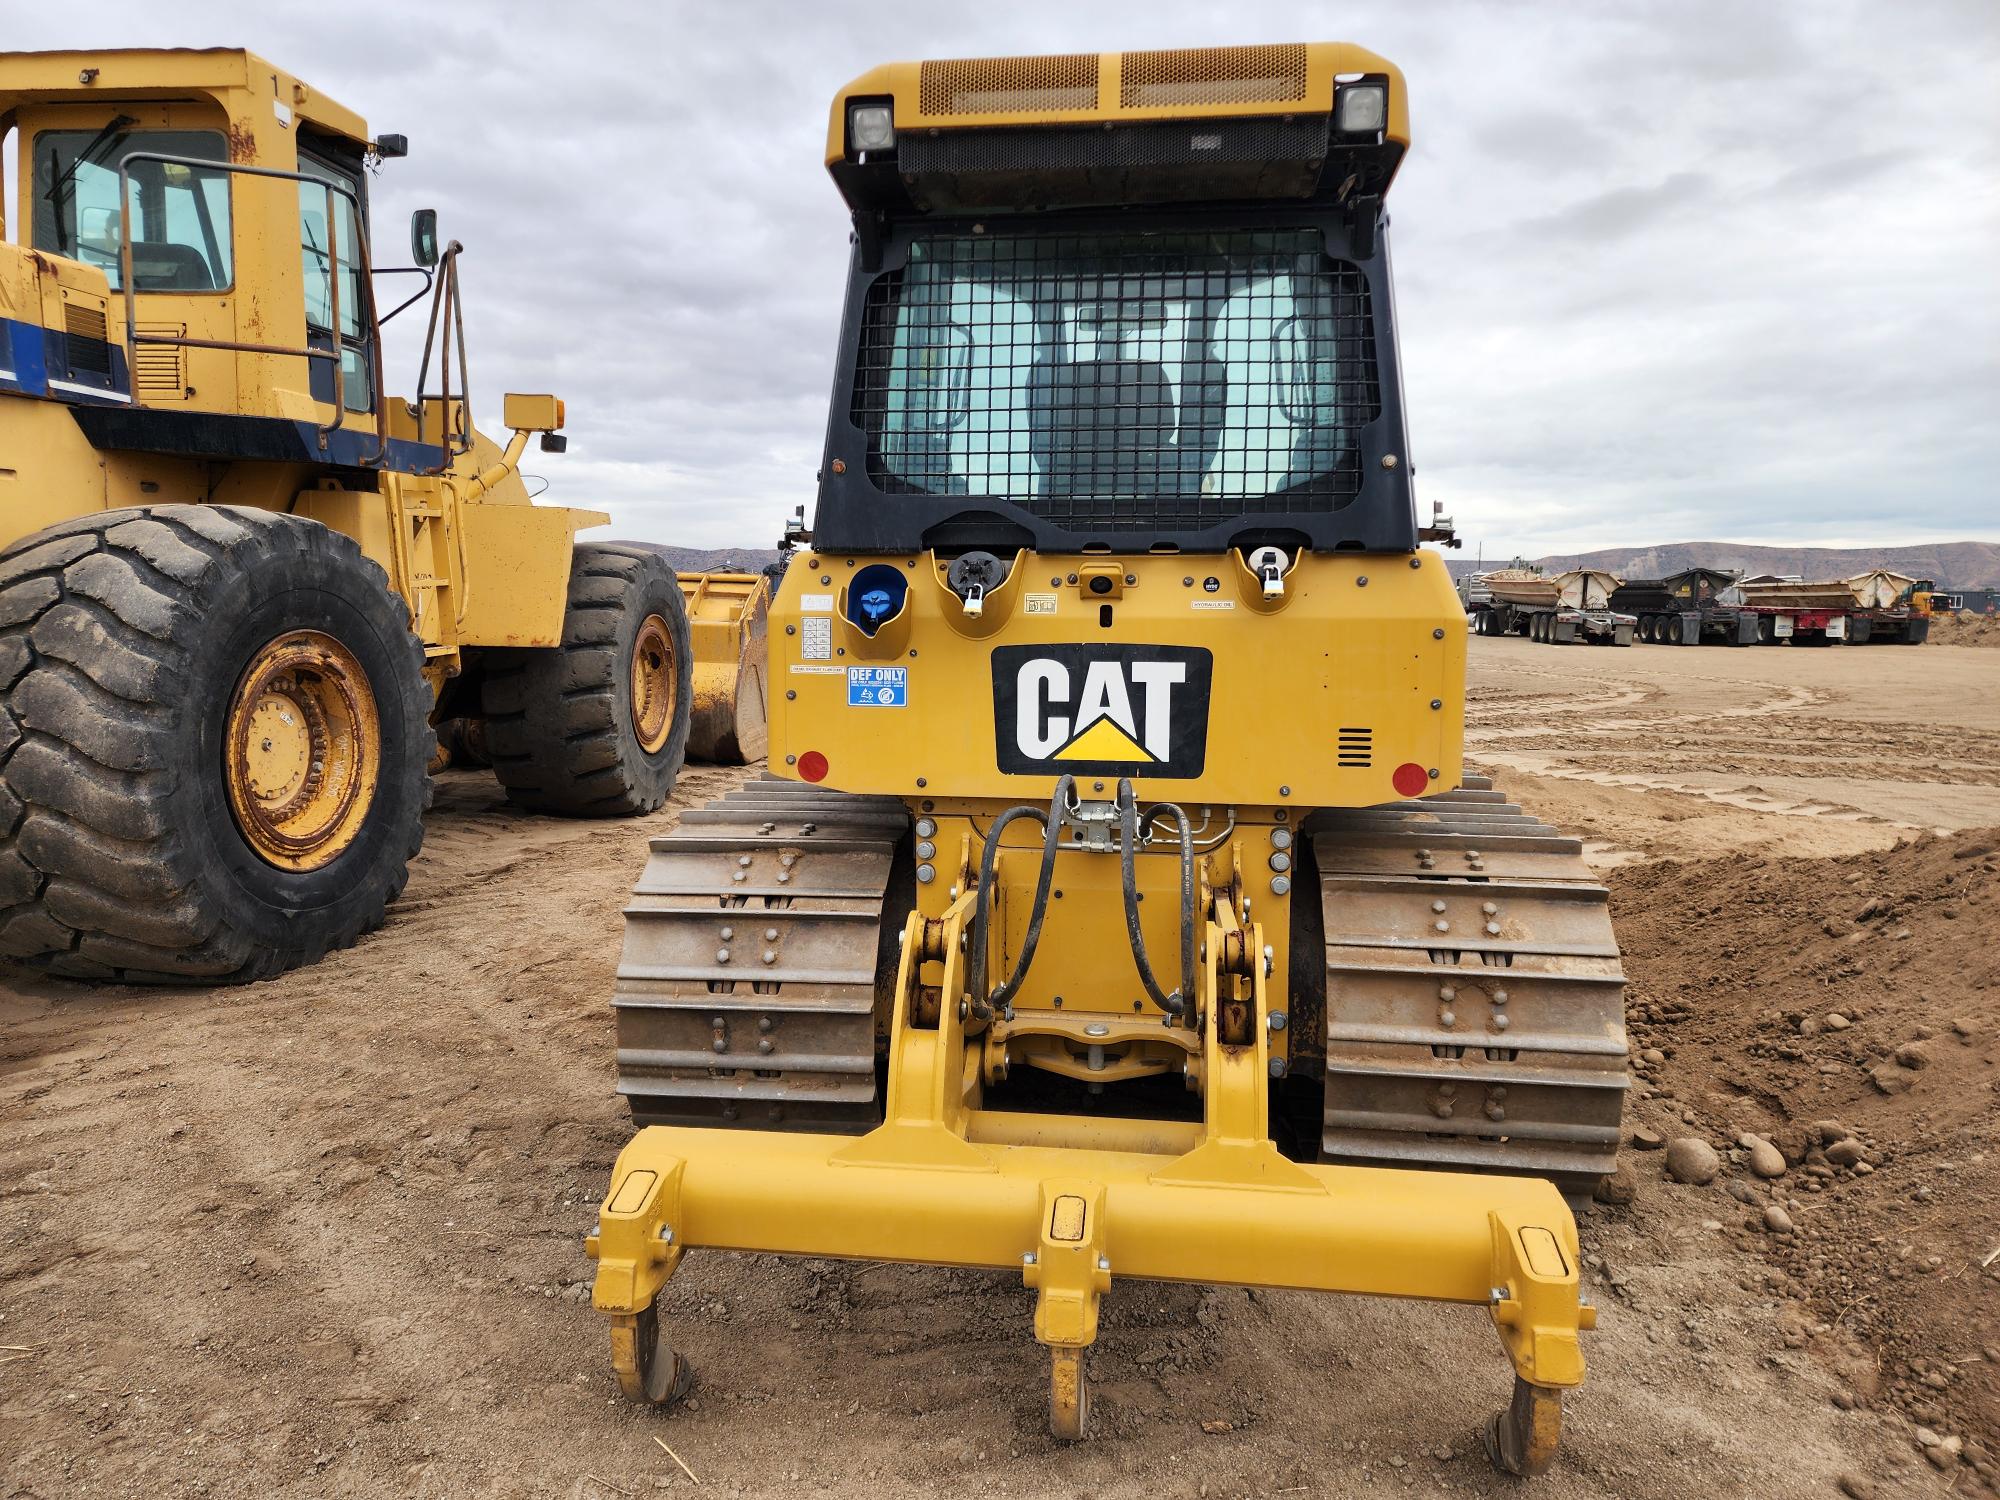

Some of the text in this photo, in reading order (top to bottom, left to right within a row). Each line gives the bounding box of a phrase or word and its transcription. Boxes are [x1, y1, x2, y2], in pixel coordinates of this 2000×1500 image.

[851, 669, 905, 681] DEF ONLY
[1017, 659, 1186, 762] CAT
